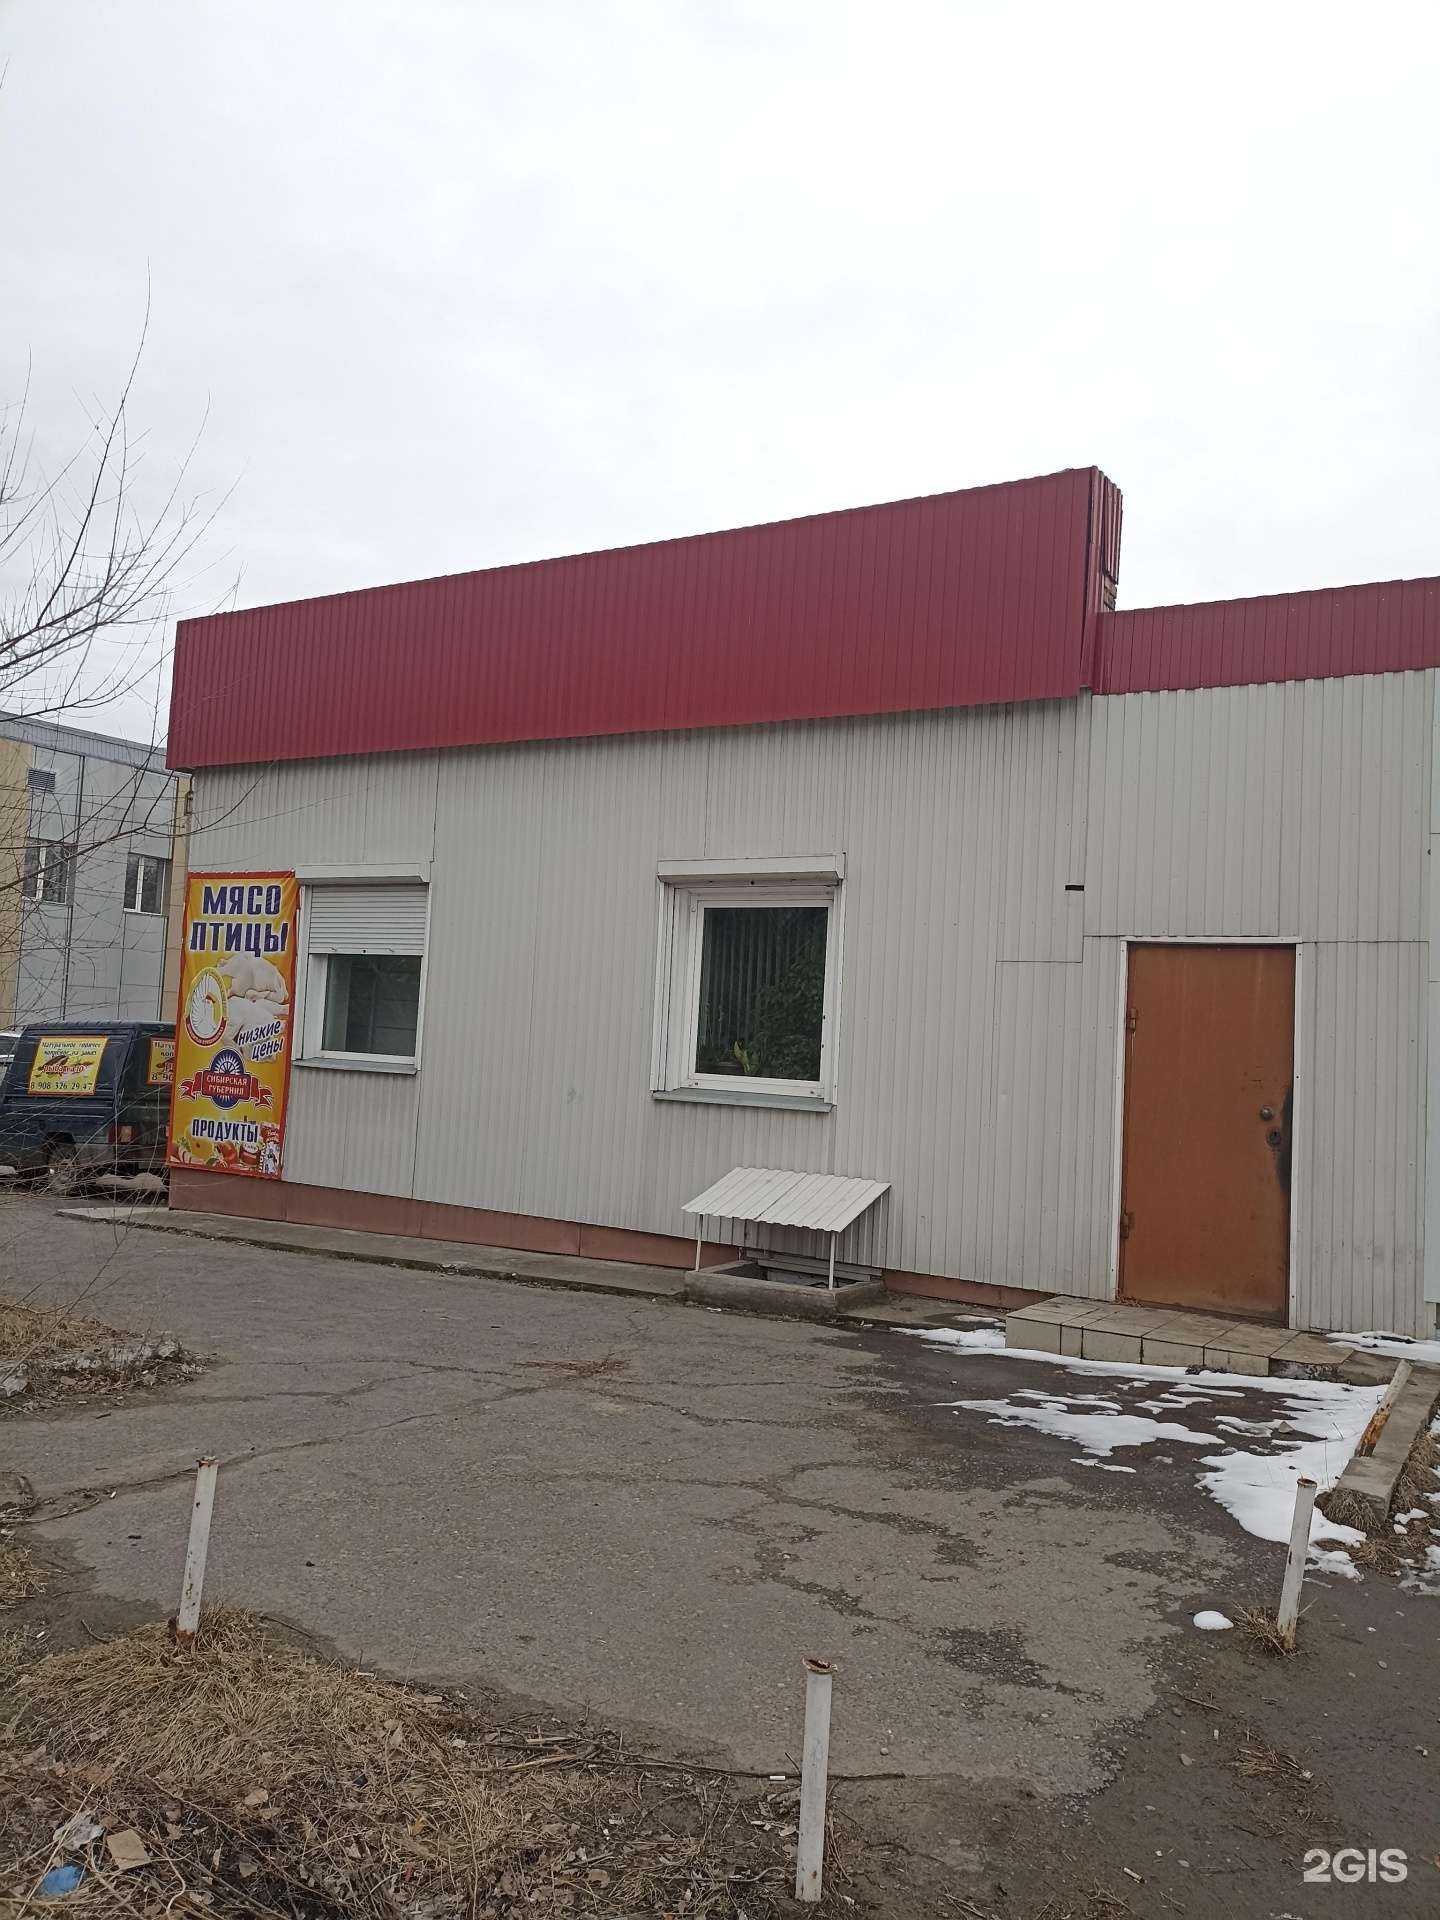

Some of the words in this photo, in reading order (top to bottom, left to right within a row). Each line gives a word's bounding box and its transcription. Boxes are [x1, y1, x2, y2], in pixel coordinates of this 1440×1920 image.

[203, 885, 281, 915] МЯСО
[190, 922, 288, 957] ПТИЦЫ
[206, 1074, 248, 1085] СИБИРСКАЯ
[192, 1119, 258, 1143] ПРОДУКТЫ
